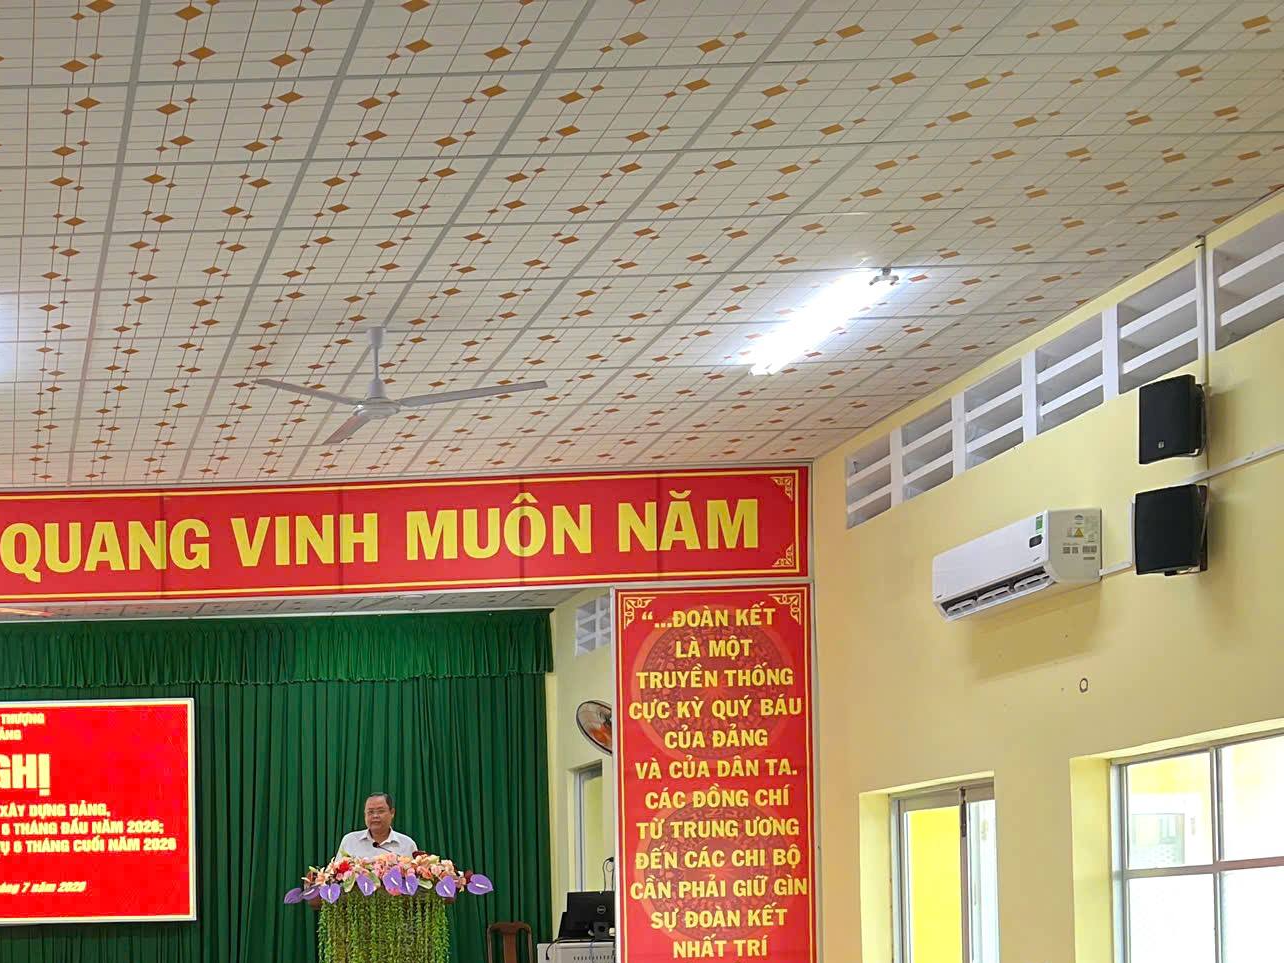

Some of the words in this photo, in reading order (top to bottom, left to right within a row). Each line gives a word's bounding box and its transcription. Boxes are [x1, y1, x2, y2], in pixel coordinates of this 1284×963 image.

[0, 517, 210, 582] QUANG
[231, 512, 378, 567] VINH
[406, 495, 595, 562] MUÔN
[618, 489, 760, 553] NĂM
[735, 602, 776, 626] KẾT
[676, 637, 700, 658] LÀ
[709, 635, 753, 660] MỘT
[636, 664, 718, 689] TRUYỀN
[724, 662, 794, 686] THỐNG
[629, 699, 670, 723] CỰC
[677, 696, 704, 718] KỲ
[712, 695, 752, 722] QUÝ
[761, 694, 802, 716] BÁU
[665, 725, 705, 749] CỦA
[712, 723, 768, 747] ĐẢNG
[635, 758, 661, 779] VÀ
[669, 755, 710, 779] CỦA
[717, 756, 759, 777] DÂN
[765, 758, 798, 776] TA.
[645, 788, 686, 809] CÁC
[693, 783, 749, 808] ĐỒNG
[755, 784, 789, 806] CHÍ
[0, 802, 25, 818] XÂY
[29, 804, 66, 819] DỰNG
[14, 820, 58, 835] THÁNG
[92, 819, 124, 834] NĂM
[636, 817, 666, 839] TỪ
[670, 821, 739, 839] TRUNG
[745, 816, 799, 837] ƯƠNG
[26, 838, 70, 853] THÁNG
[73, 835, 104, 852] CUỐI
[108, 836, 140, 851] NĂM
[635, 846, 678, 870] ĐẾN
[684, 846, 725, 869] CÁC
[731, 849, 764, 867] CHI
[773, 844, 801, 870] BỘ
[22, 882, 31, 893] 7
[630, 875, 672, 900] CẦN
[678, 874, 726, 898] PHẢI
[733, 874, 768, 897] GIỮ
[773, 874, 808, 896] GÌN
[651, 906, 678, 932] SỰ
[684, 907, 741, 929] ĐOÀN
[747, 903, 788, 926] KẾT
[673, 934, 727, 958] NHẤT
[733, 935, 768, 956] TRÍ
